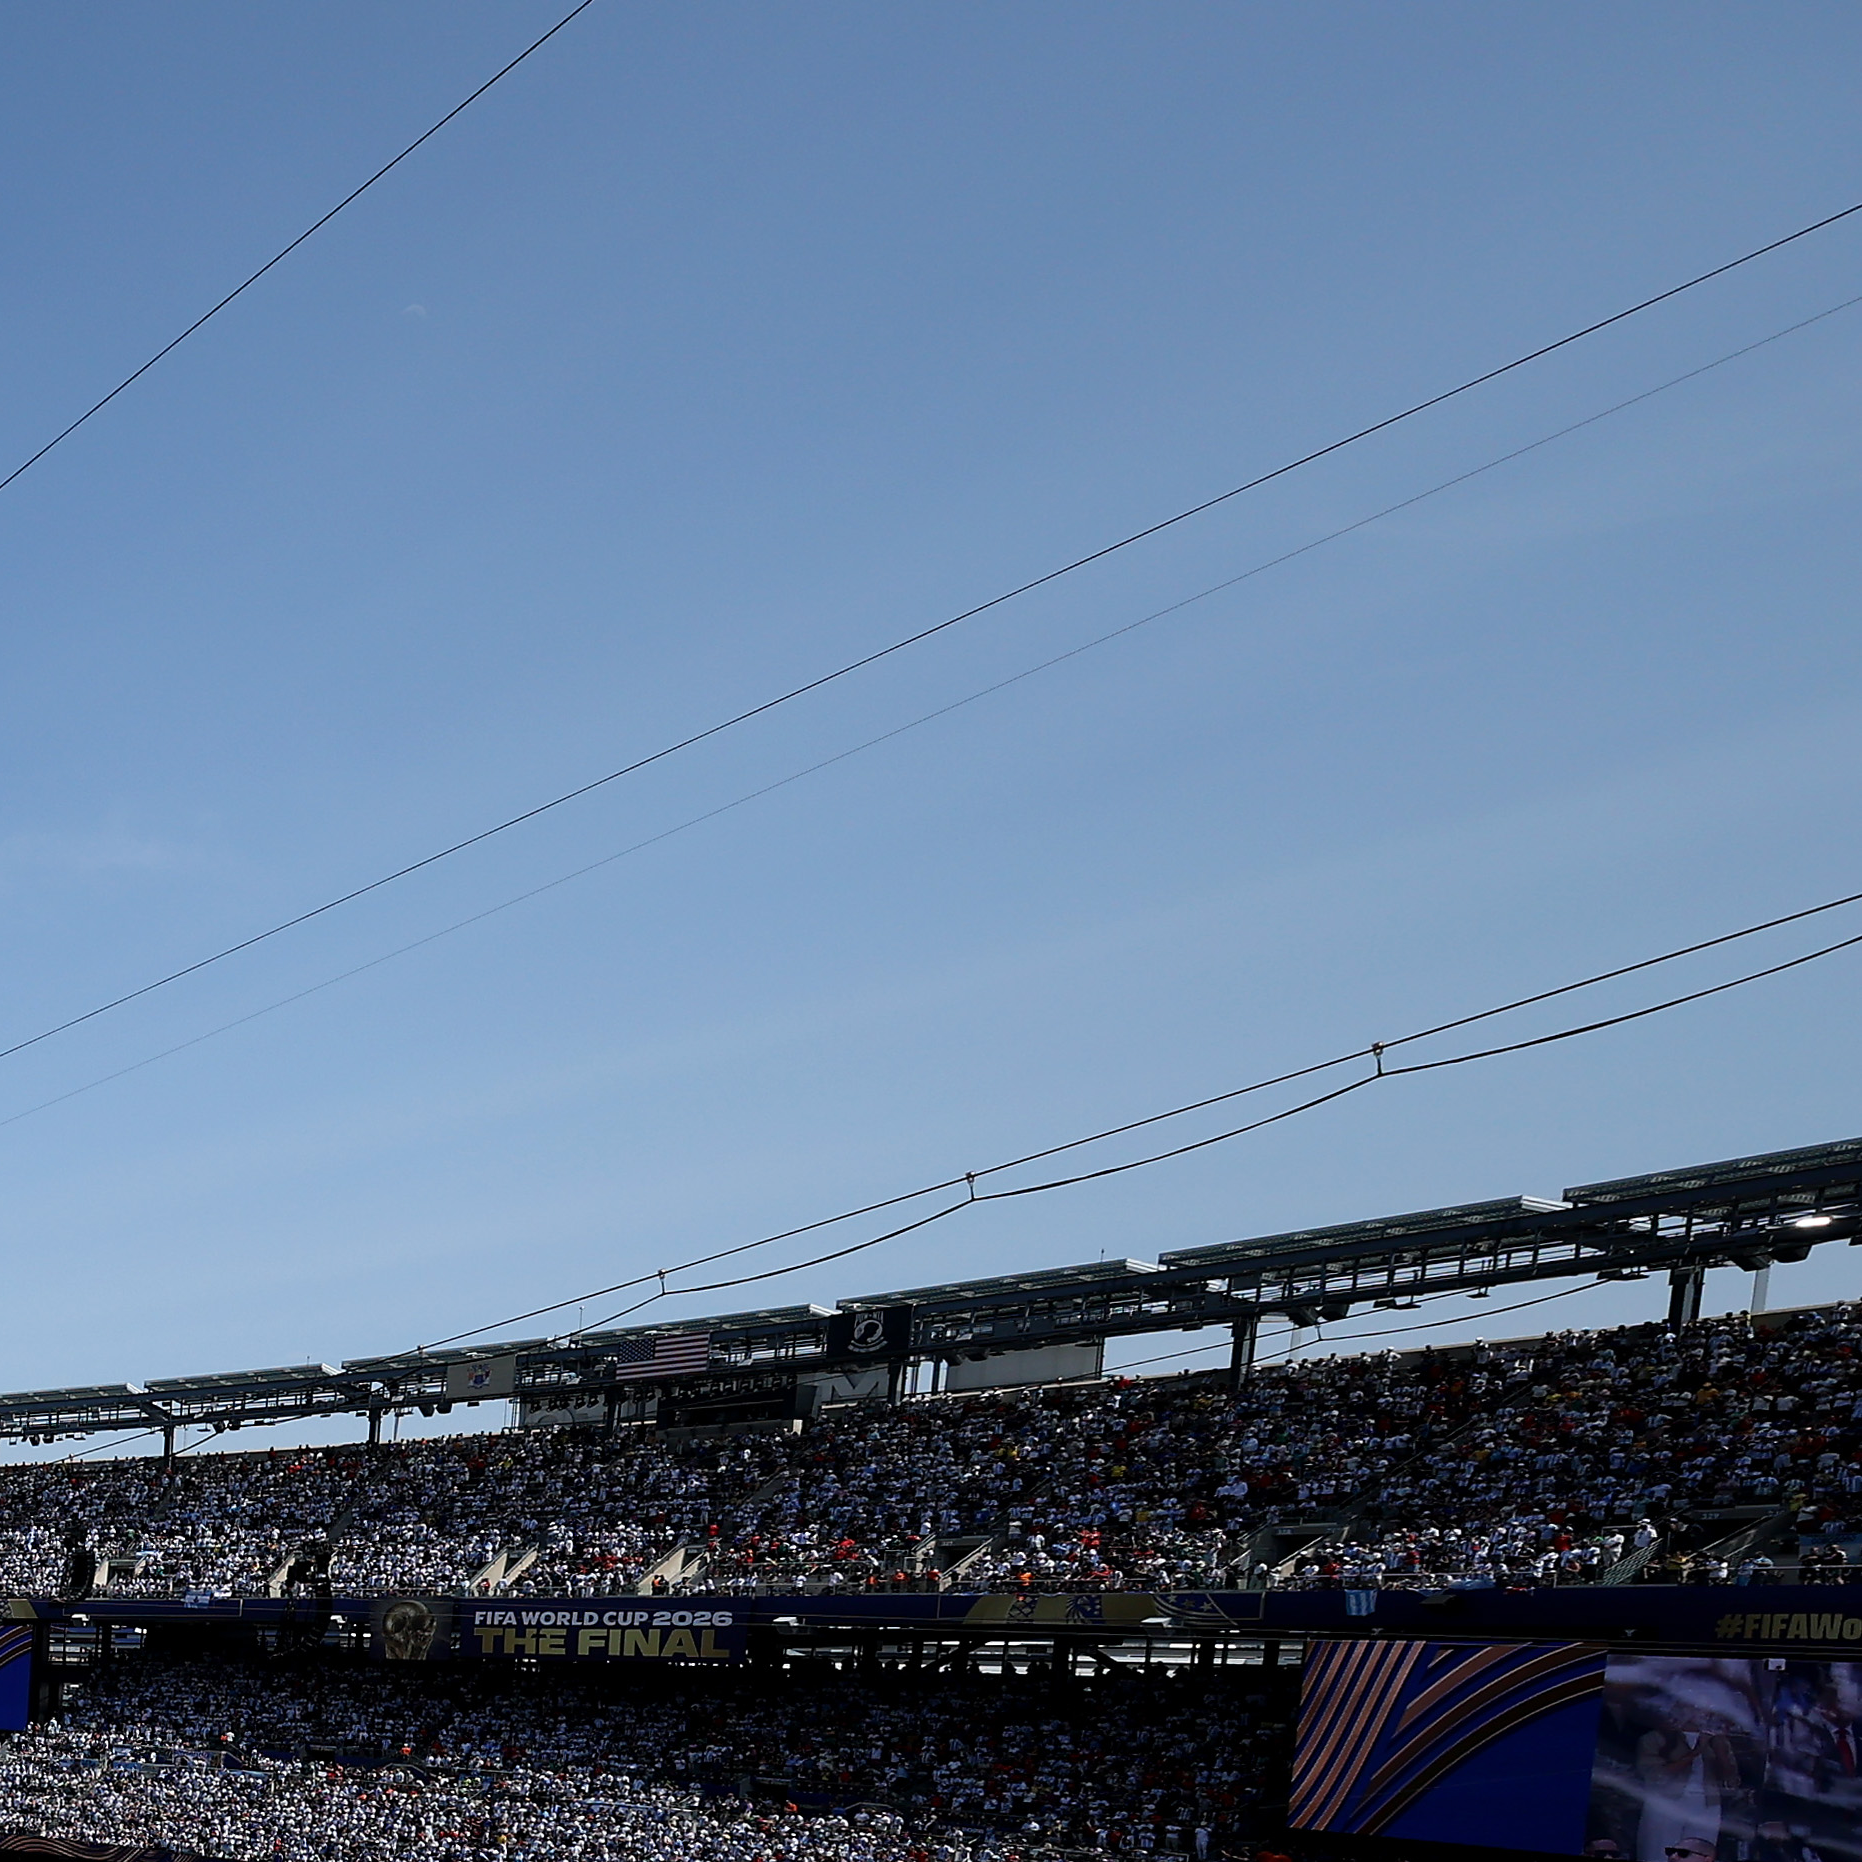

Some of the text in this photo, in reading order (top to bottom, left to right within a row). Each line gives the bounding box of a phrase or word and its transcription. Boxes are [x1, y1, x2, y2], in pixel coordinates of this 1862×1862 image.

[474, 1610, 733, 1627] FIFA WORLD CUP 2026
[1715, 1613, 1862, 1640] #FIFAWo
[473, 1628, 731, 1658] THE FINAL
